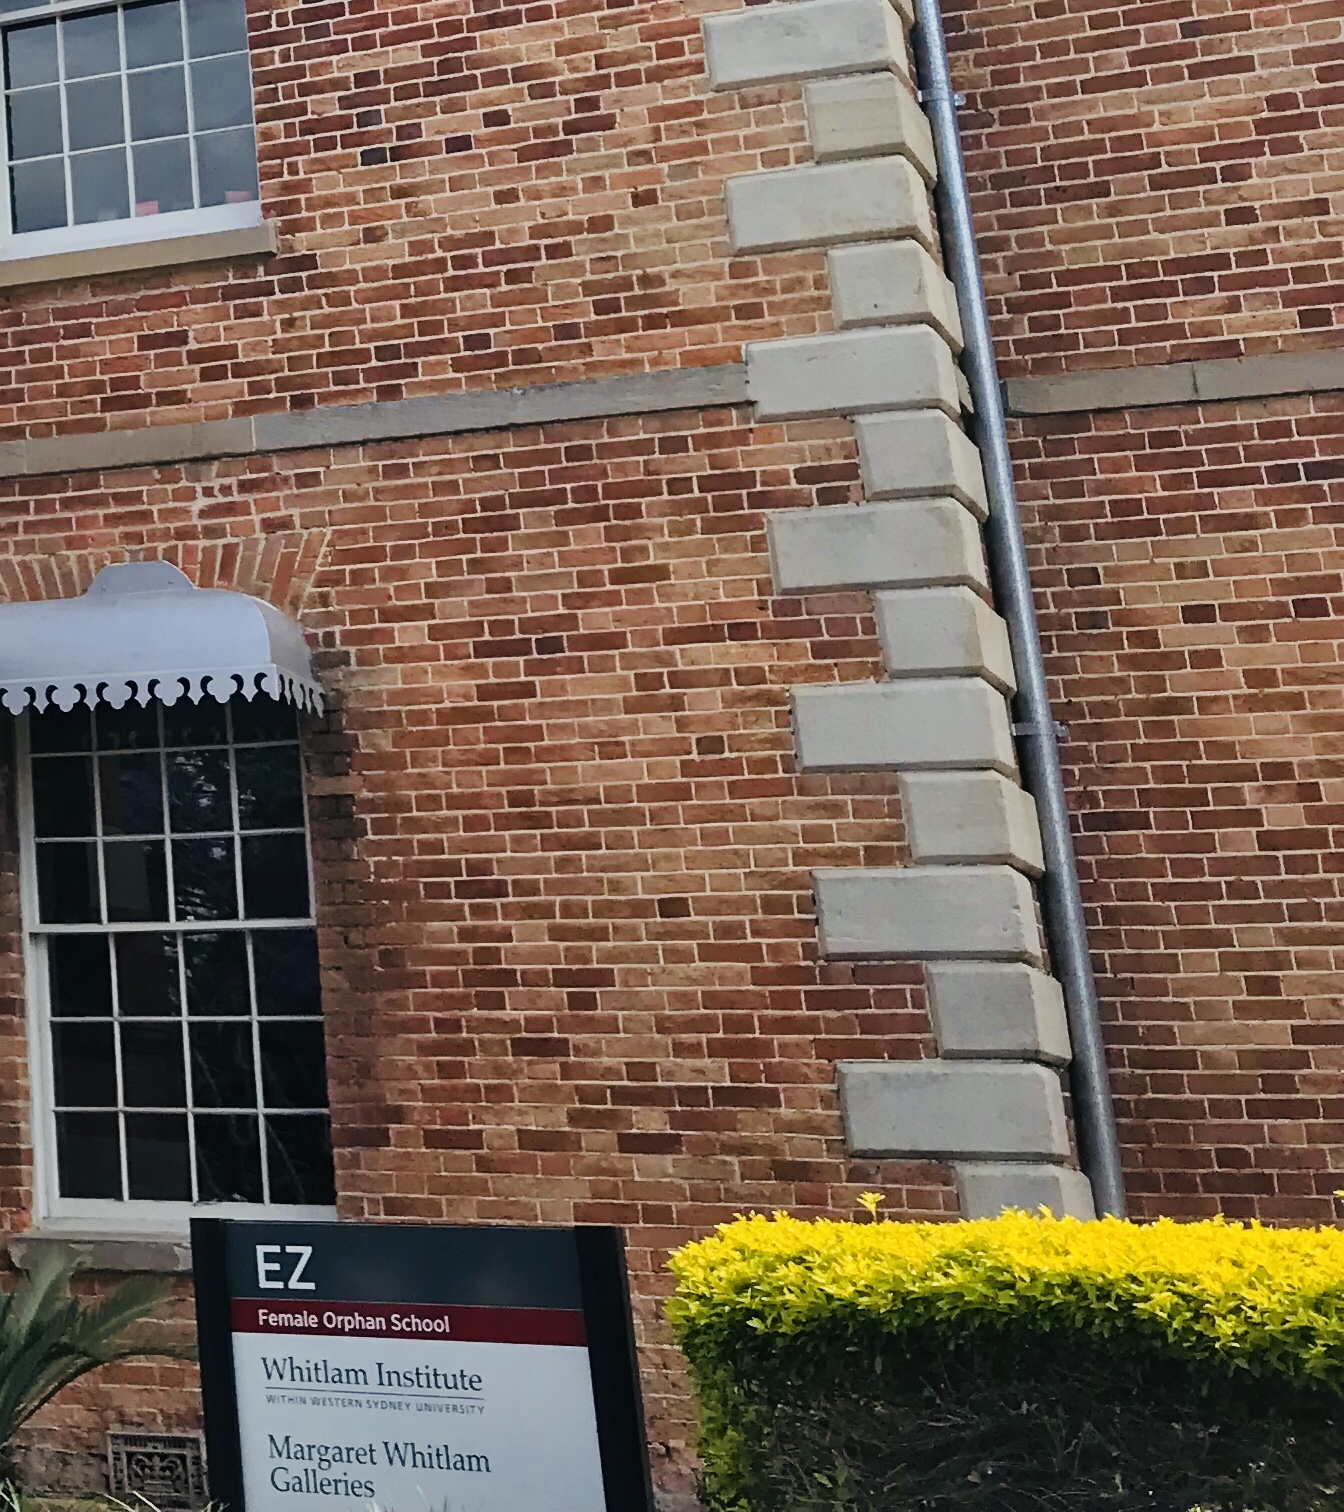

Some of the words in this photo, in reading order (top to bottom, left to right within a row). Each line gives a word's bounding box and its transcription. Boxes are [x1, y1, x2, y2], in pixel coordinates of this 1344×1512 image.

[255, 1244, 316, 1290] EZ
[258, 1309, 319, 1328] Female
[322, 1311, 387, 1333] Orphan
[390, 1313, 450, 1334] School
[260, 1356, 370, 1386] Whitlam
[375, 1362, 483, 1392] Institute
[265, 1394, 308, 1405] WITHIN
[310, 1396, 363, 1408] WESTERN
[366, 1399, 411, 1411] SYDNEY
[415, 1402, 485, 1415] UNIVERSITY
[267, 1434, 377, 1471] Margaret
[382, 1441, 492, 1473] Whitlam
[270, 1466, 376, 1499] Galleries
